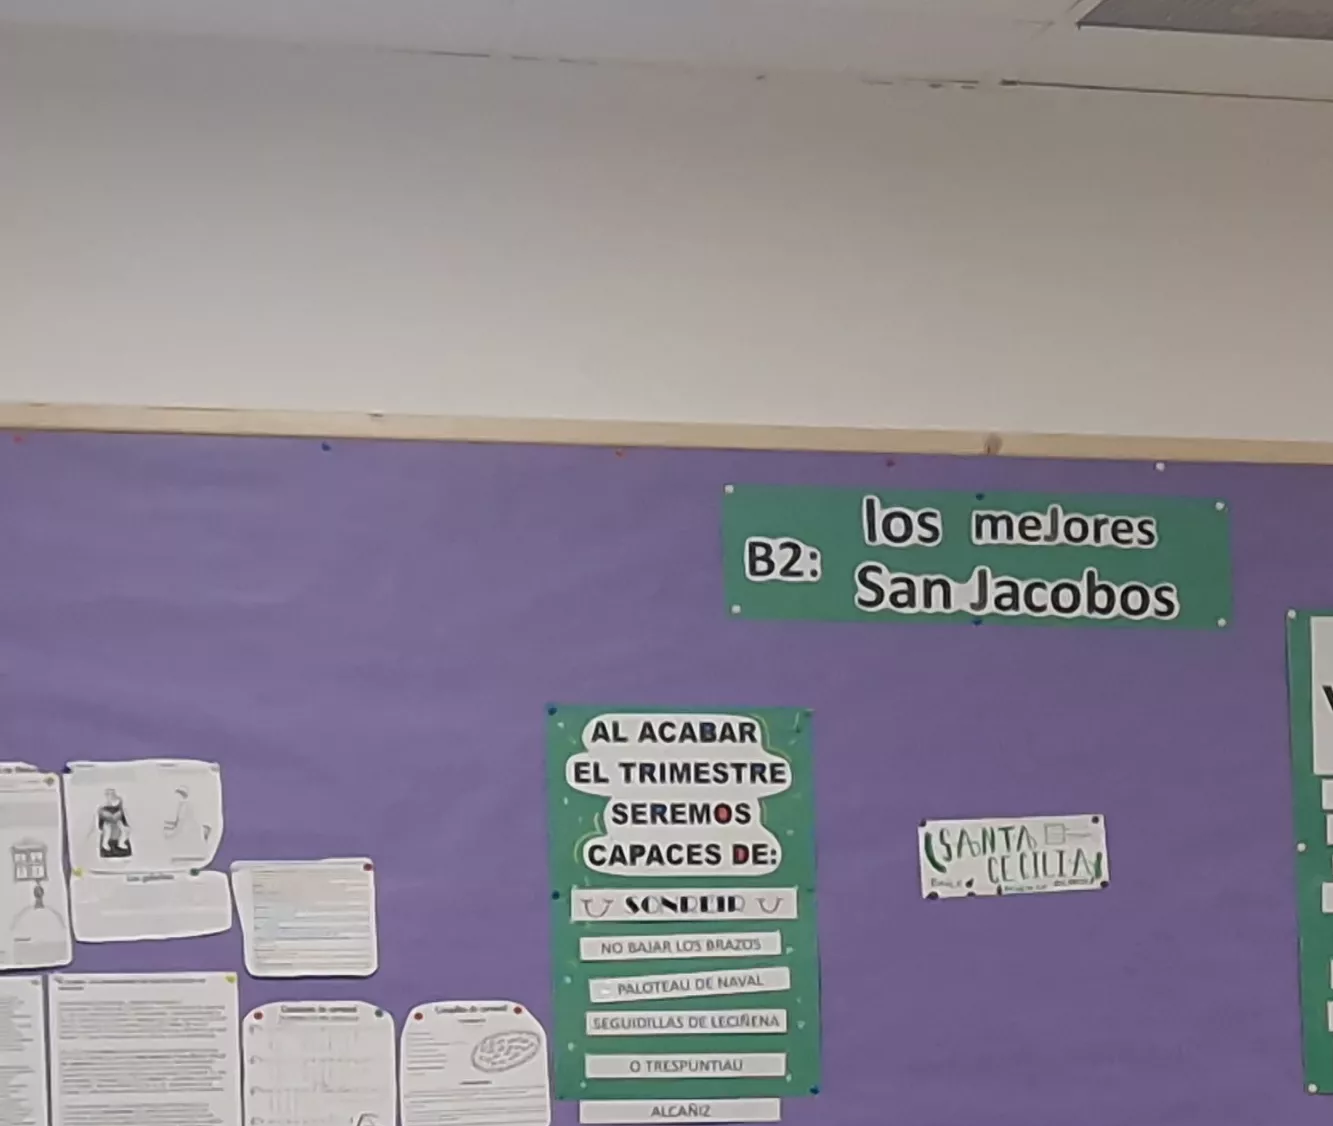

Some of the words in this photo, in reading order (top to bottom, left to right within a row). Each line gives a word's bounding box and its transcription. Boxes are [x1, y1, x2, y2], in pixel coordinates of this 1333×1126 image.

[866, 497, 940, 543] los
[749, 540, 818, 577] B2:
[857, 565, 951, 609] San
[969, 568, 1175, 617] Jacobos
[591, 721, 628, 743] AL
[638, 721, 757, 743] ACABAR
[574, 762, 609, 784] EL
[619, 762, 787, 784] TRIMESTRE
[611, 803, 751, 825] SEREMOS
[938, 825, 1037, 862] SANTA
[587, 844, 722, 866] CAPACES
[732, 844, 778, 866] DE:
[987, 848, 1092, 884] CECILIA
[624, 895, 746, 914] SONREIR
[601, 942, 623, 955] NO
[628, 940, 671, 954] BAJAR
[676, 939, 702, 952] LOS
[706, 938, 762, 951] BRAZOS
[617, 979, 690, 996] PALOTEAU
[695, 977, 712, 991] DE
[717, 974, 764, 989] NAVAL
[593, 1015, 684, 1030] SEGUIDILLAS
[688, 1015, 705, 1029] DE
[710, 1012, 780, 1028] LECIÑENA
[630, 1060, 641, 1073] O
[646, 1058, 743, 1073] TRESPUNTIAU
[651, 1102, 711, 1118] ALCAÑIZ
